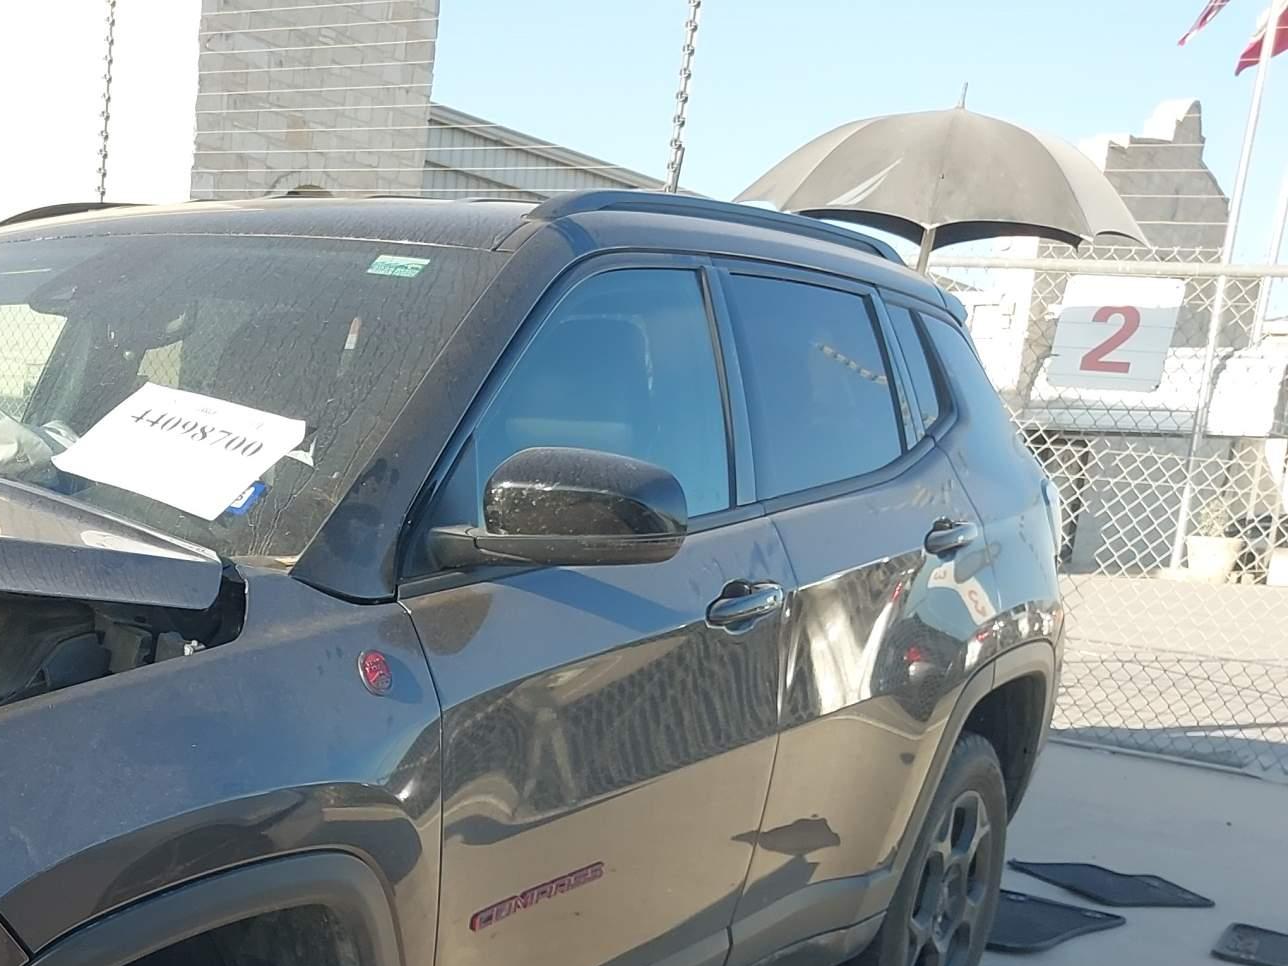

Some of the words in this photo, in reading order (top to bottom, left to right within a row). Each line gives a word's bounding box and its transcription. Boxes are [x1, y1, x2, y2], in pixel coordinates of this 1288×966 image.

[1080, 305, 1141, 374] 2
[130, 408, 264, 457] 44098700
[469, 861, 604, 931] COMPASS
